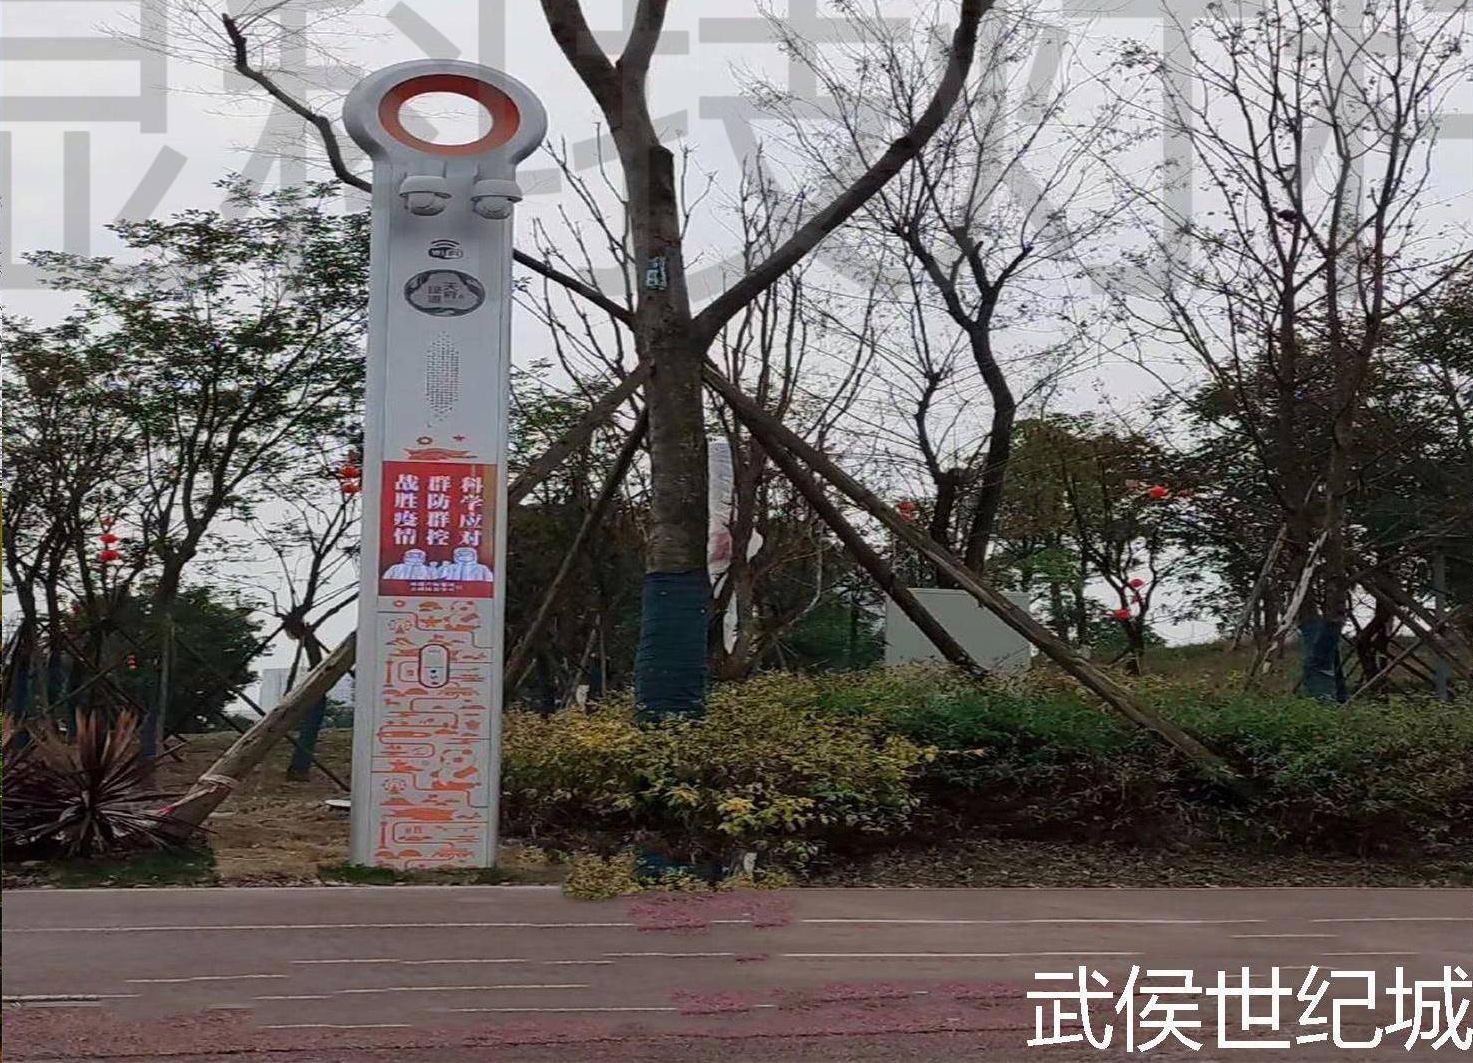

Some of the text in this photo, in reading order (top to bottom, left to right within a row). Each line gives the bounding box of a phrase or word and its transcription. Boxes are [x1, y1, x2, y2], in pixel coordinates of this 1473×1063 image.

[393, 474, 420, 545] 战胜疫情
[426, 475, 452, 546] 群防群控
[458, 476, 484, 547] 科学应对
